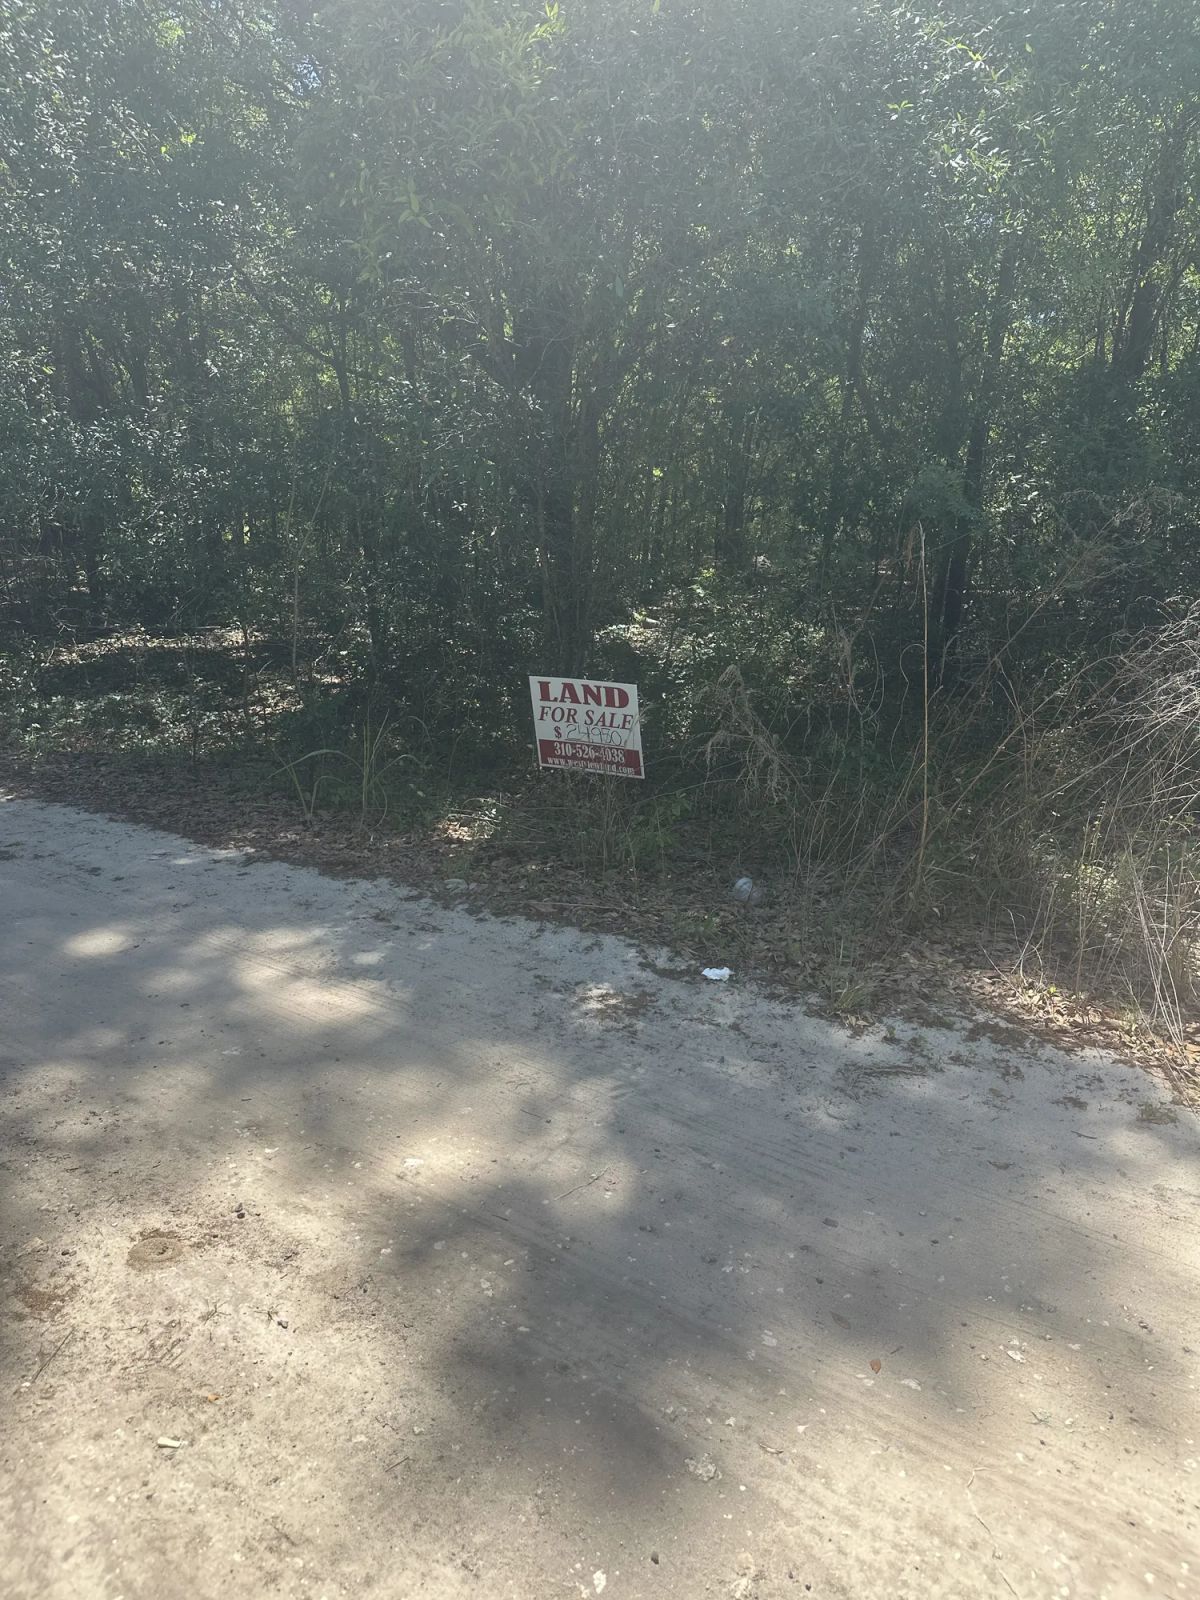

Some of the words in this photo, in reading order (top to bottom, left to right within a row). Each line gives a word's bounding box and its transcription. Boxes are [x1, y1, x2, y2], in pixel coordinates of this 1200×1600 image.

[538, 681, 629, 708] LAND
[538, 706, 578, 724] FOR
[584, 710, 633, 730] SALE
[553, 742, 625, 763] 310-526-4038
